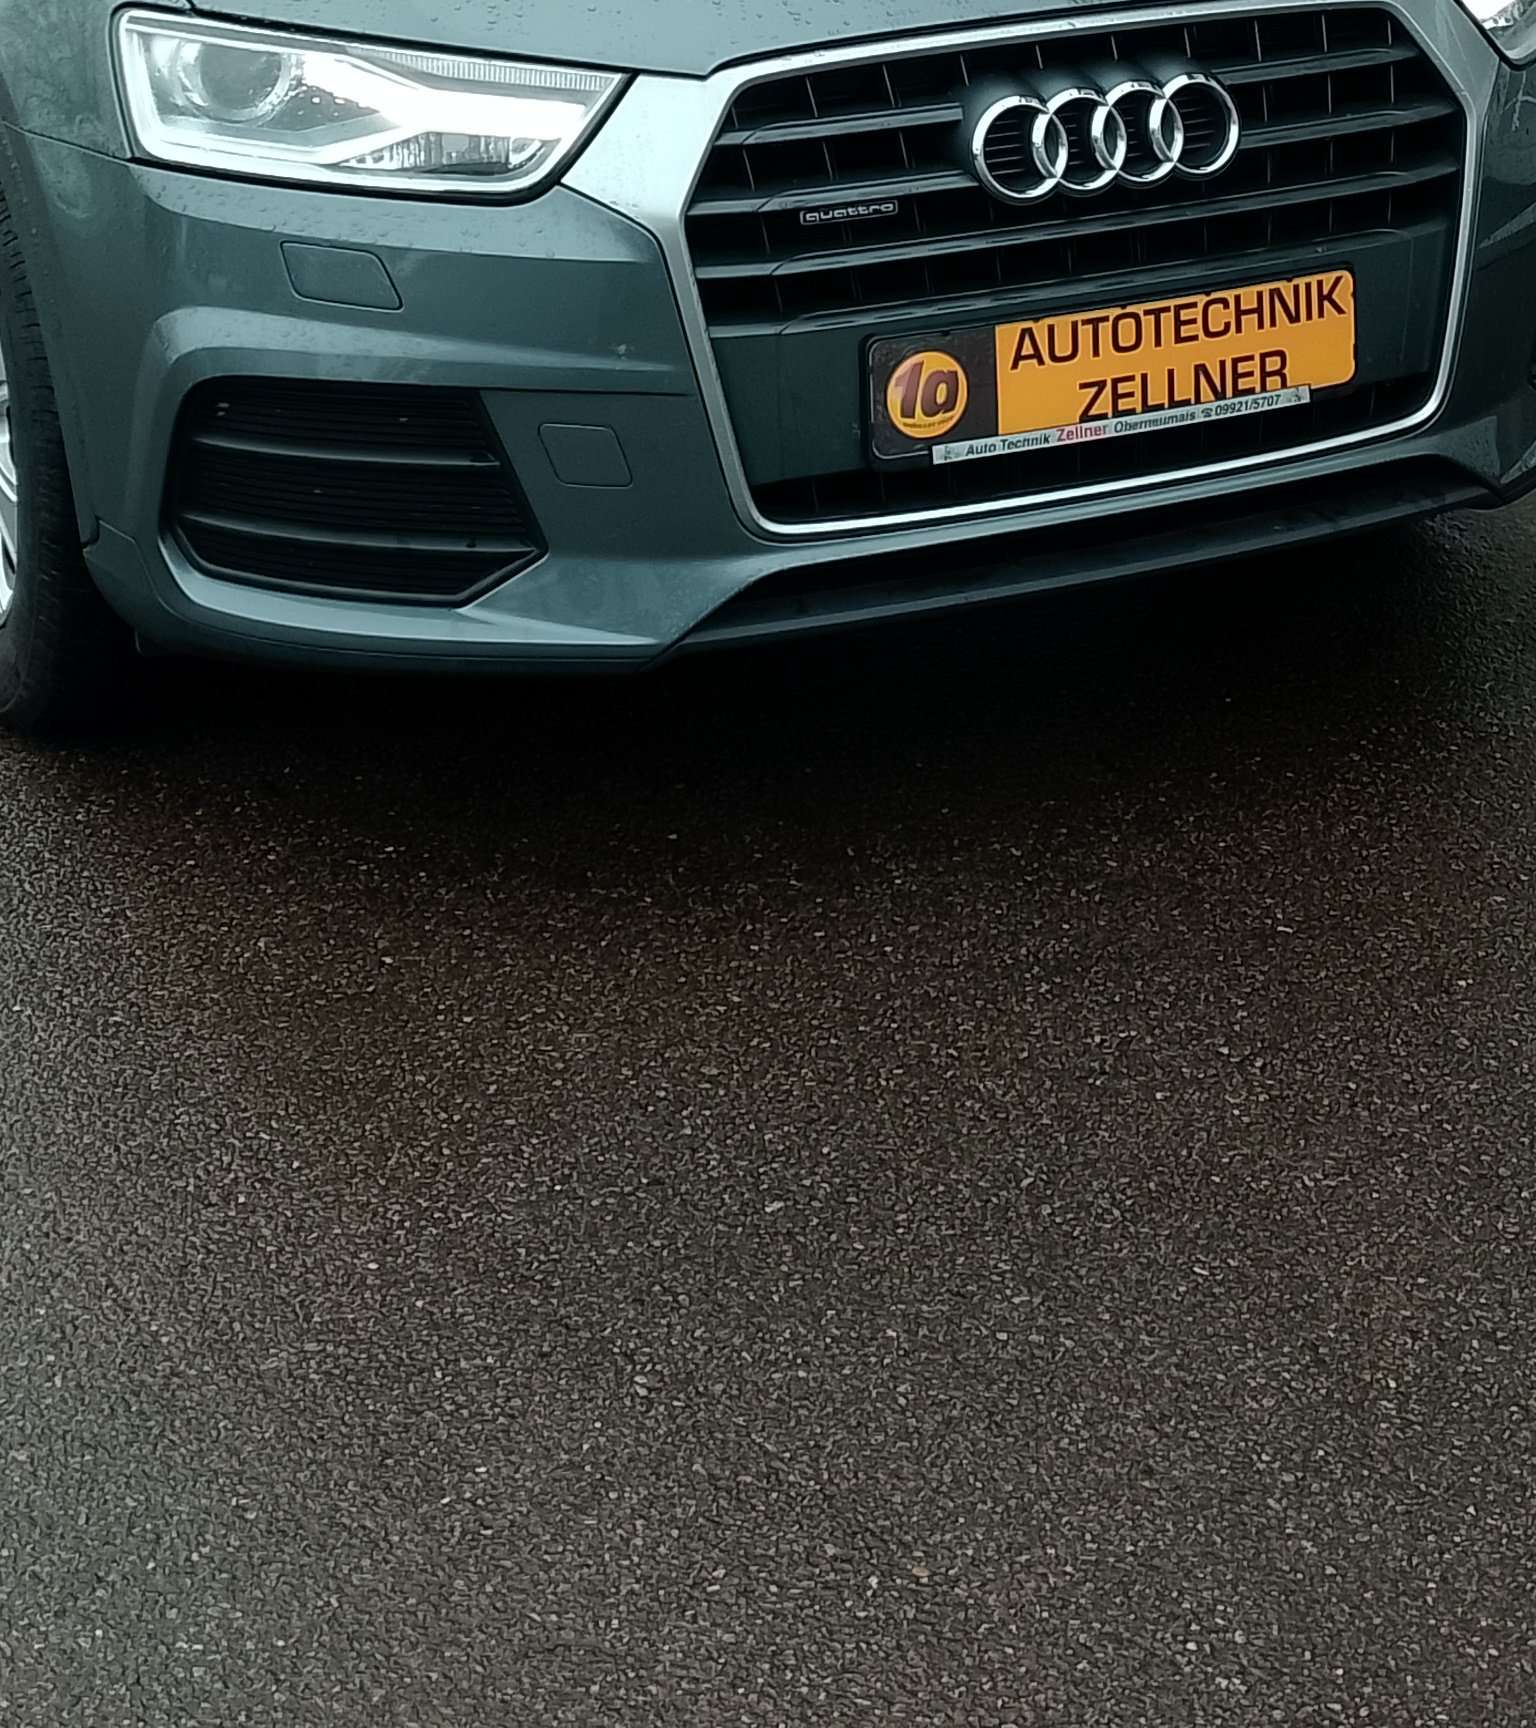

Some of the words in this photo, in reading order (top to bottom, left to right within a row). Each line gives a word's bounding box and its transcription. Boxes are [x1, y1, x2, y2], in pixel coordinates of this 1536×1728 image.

[805, 203, 894, 223] quattro
[1009, 275, 1347, 371] AUTOTECHNIK
[1077, 349, 1288, 423] ZELLNER
[965, 444, 997, 457] Auto
[999, 433, 1051, 451] Technik
[1055, 423, 1108, 443] Zellner
